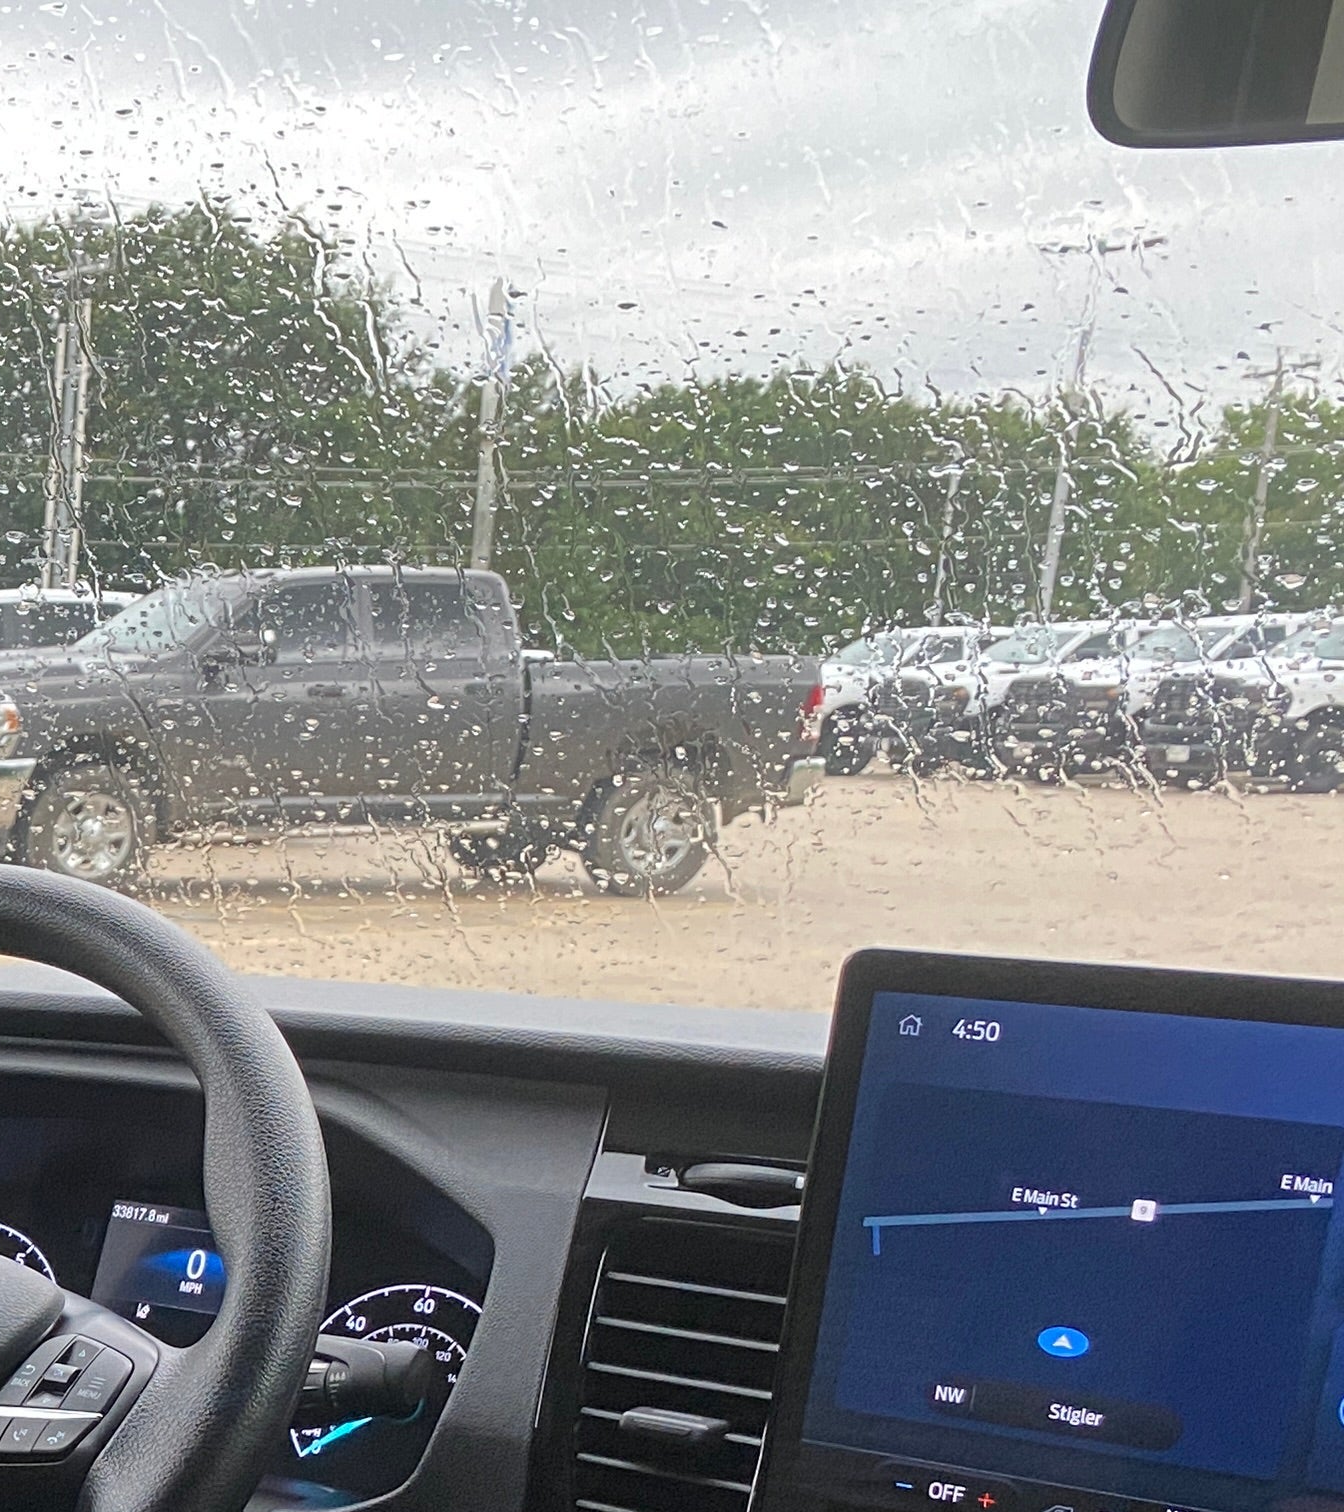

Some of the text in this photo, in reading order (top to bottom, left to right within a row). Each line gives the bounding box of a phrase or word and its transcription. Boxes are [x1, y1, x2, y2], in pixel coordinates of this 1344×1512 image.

[952, 1019, 1000, 1042] 4:50
[1281, 1174, 1333, 1194] E Main
[1012, 1187, 1079, 1209] E Main St
[187, 1249, 207, 1281] 0
[179, 1280, 203, 1296] MPH
[413, 1298, 436, 1315] 60
[345, 1315, 367, 1332] 40
[435, 1350, 452, 1363] 120
[76, 1387, 102, 1401] MENU
[934, 1384, 965, 1405] NW
[1048, 1402, 1104, 1429] Stigler
[928, 1481, 966, 1503] OFF
